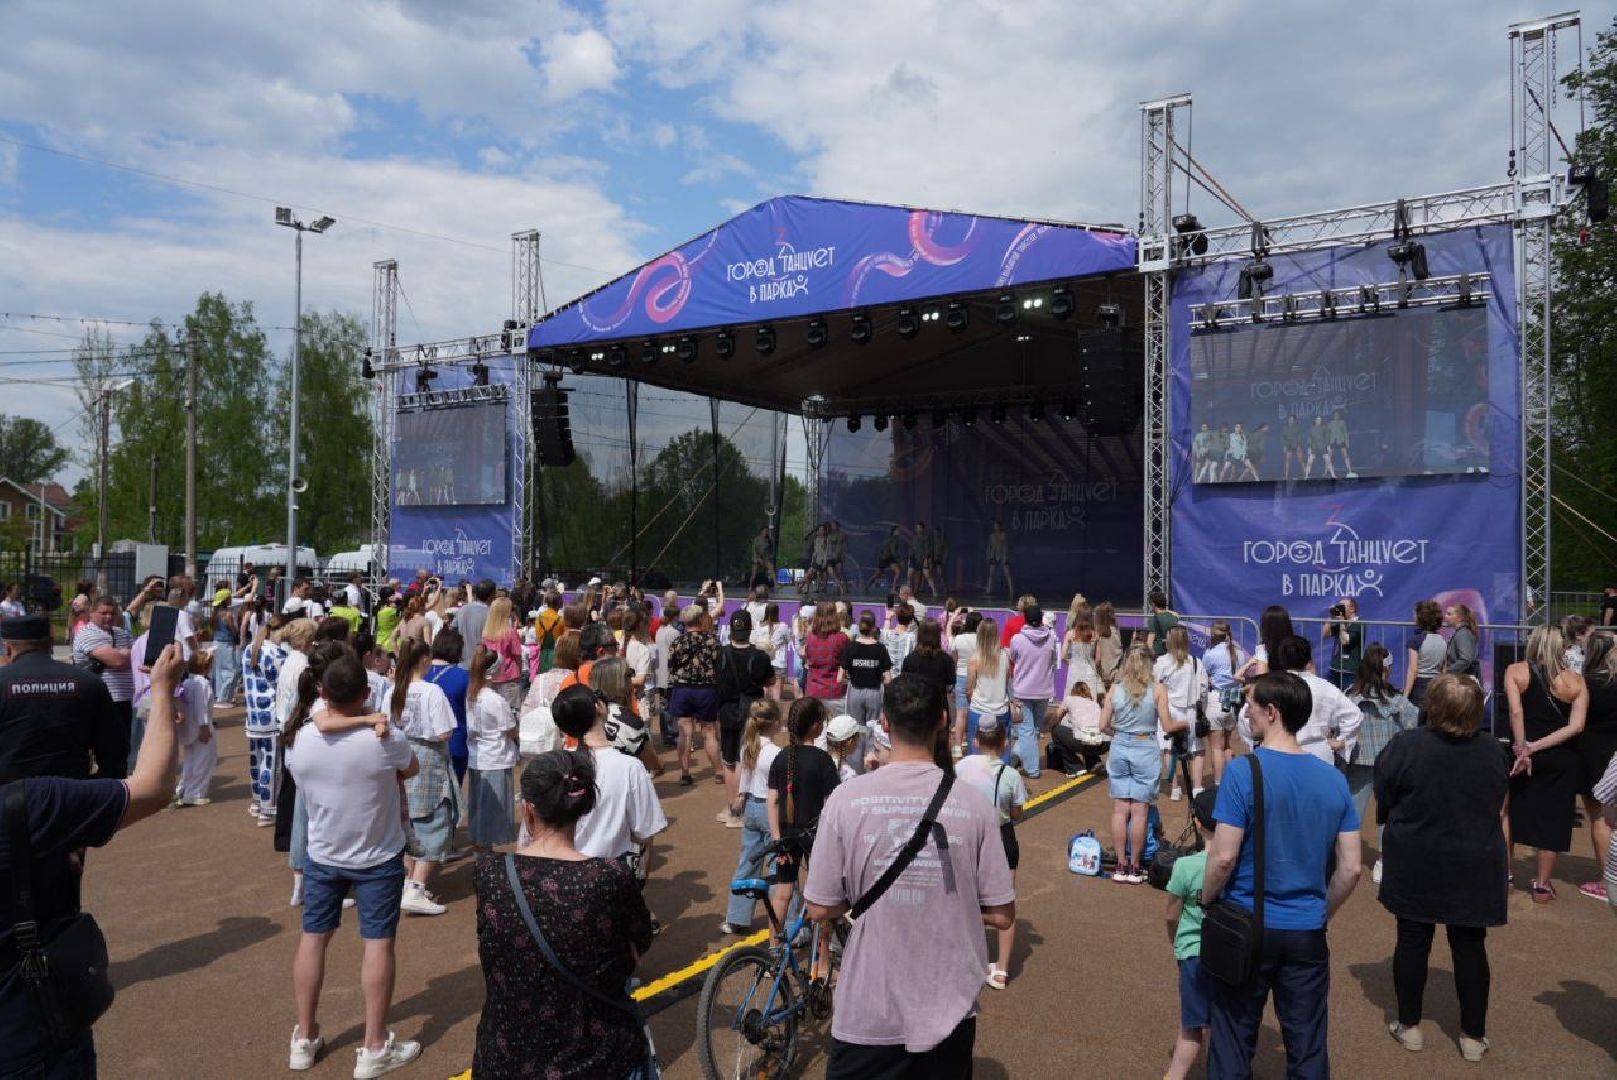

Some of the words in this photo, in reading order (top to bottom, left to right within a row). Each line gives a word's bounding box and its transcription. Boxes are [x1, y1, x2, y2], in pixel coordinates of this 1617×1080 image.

[727, 256, 775, 281] ГОРОД
[778, 245, 836, 273] ТАНЦУЕТ
[749, 284, 758, 304] В
[1243, 540, 1326, 565] ГОРОД
[1330, 539, 1429, 565] ТАНЦУЕТ
[1282, 573, 1293, 596] В
[11, 682, 75, 695] ПОЛИЦИЯ
